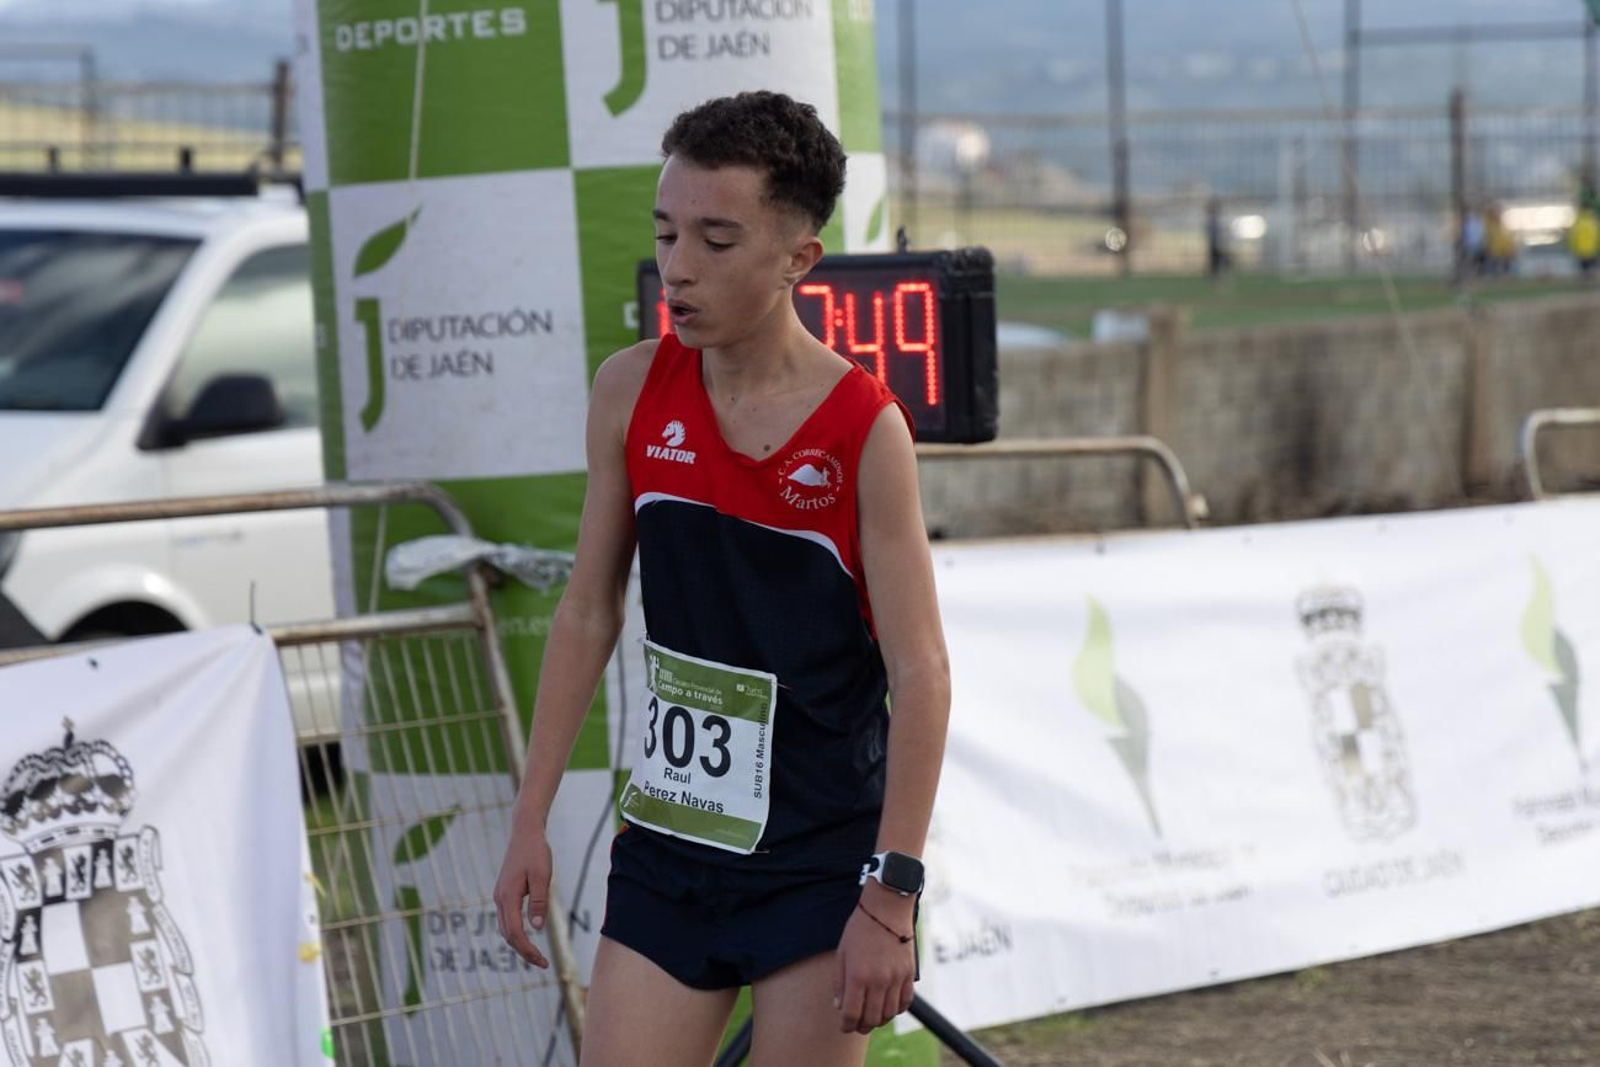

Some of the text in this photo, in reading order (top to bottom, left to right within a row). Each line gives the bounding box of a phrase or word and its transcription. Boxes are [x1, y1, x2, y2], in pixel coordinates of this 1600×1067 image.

[334, 7, 527, 52] DEPORTES
[656, 28, 771, 61] DE JAÉN
[387, 304, 554, 345] DIPUTACIÓN
[390, 346, 494, 382] DE JAÉN
[646, 444, 697, 465] VIATOR
[779, 486, 837, 510] Martos
[657, 680, 685, 697] Campo
[693, 691, 724, 706] través
[643, 696, 732, 778] 303
[756, 702, 769, 760] Masculino
[663, 766, 692, 785] Raul
[753, 762, 764, 799] SUB16
[643, 779, 725, 815] Perez Navas
